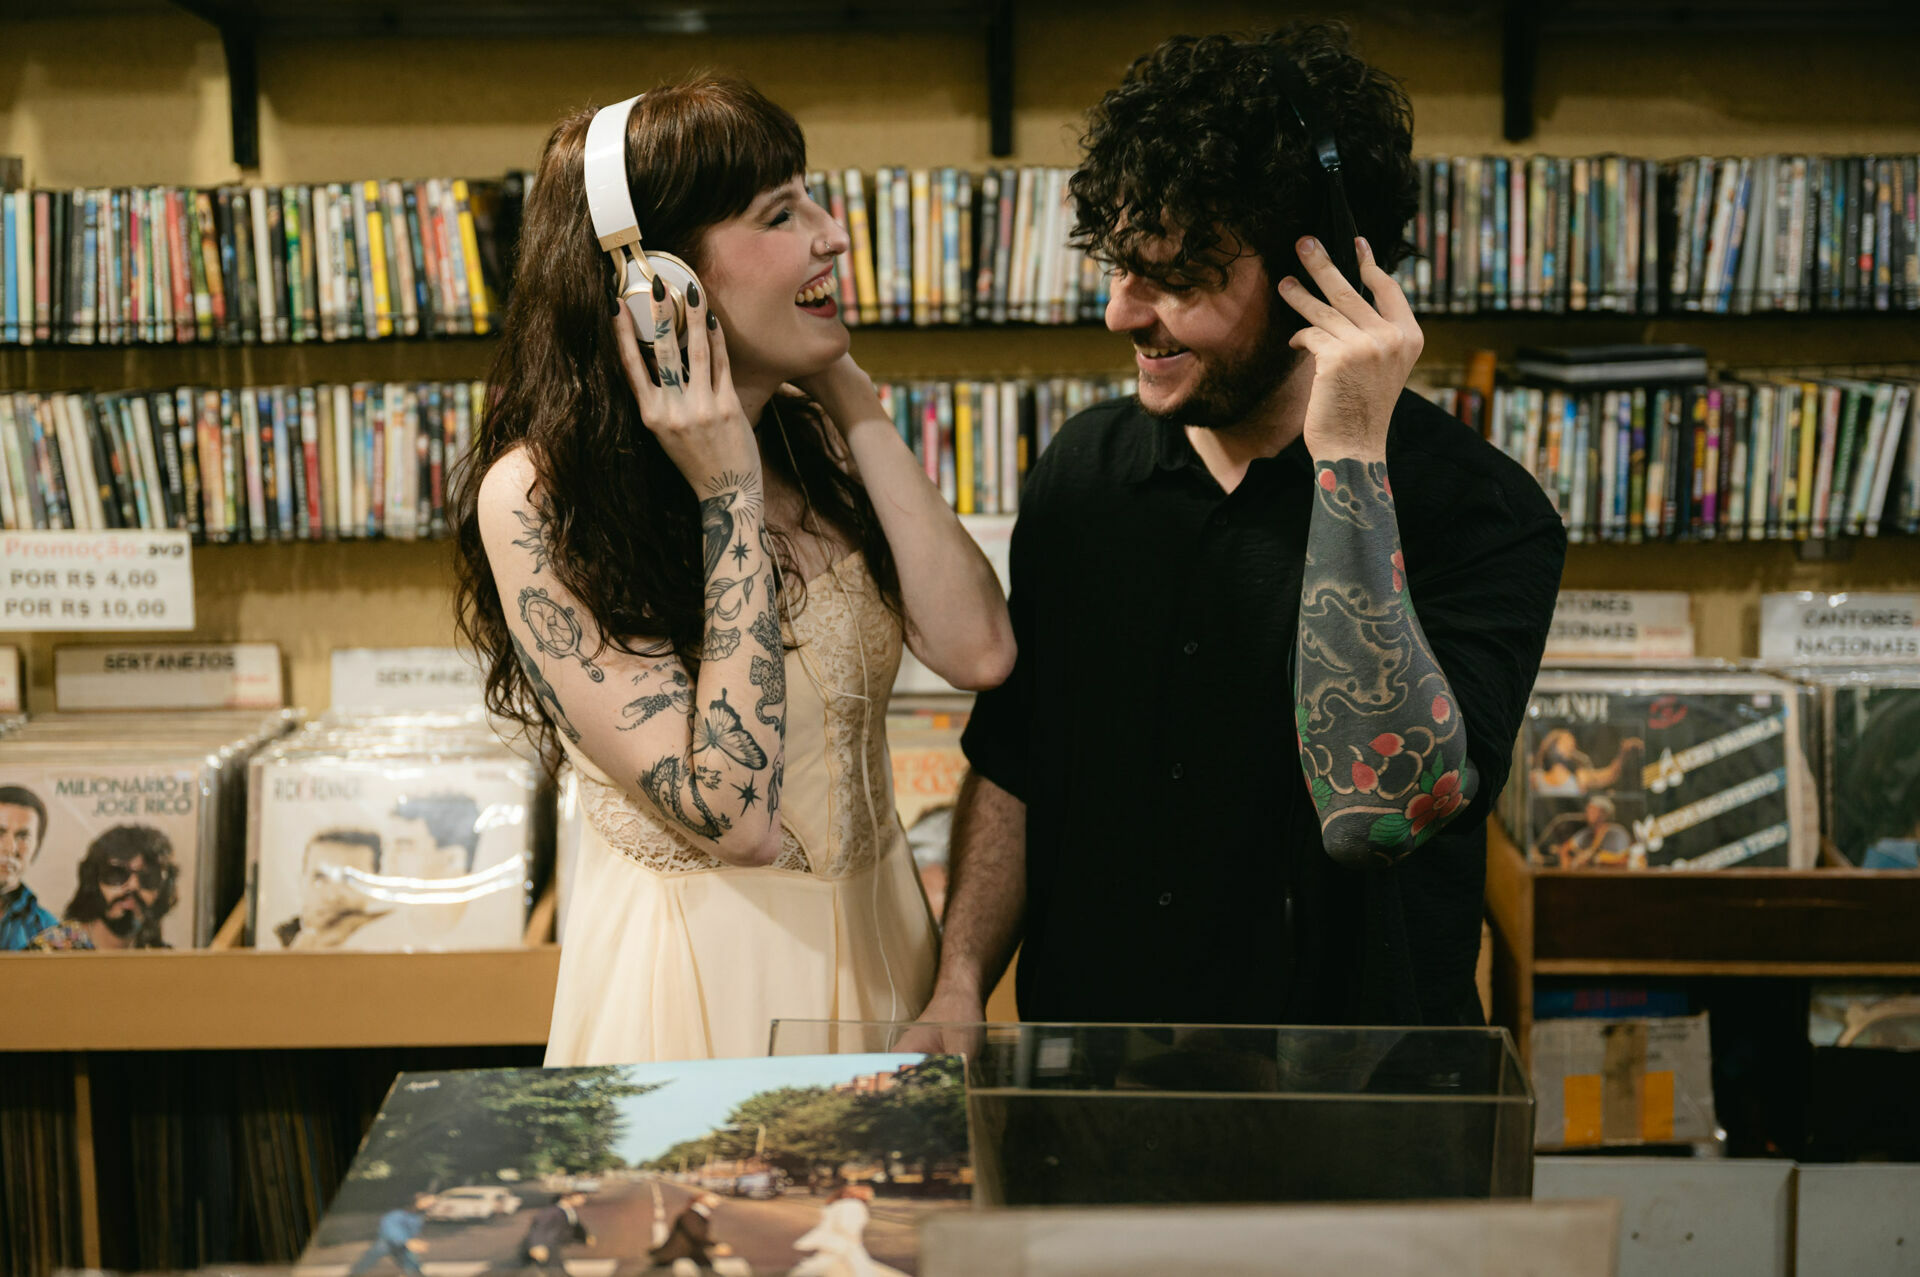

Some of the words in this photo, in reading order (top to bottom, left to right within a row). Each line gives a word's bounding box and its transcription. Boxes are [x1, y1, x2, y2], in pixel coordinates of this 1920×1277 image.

[10, 569, 58, 588] POR
[67, 569, 97, 589] R$
[107, 569, 158, 590] 4,00
[5, 599, 52, 618] POR
[61, 599, 91, 619] R$
[101, 599, 166, 620] 10,00
[1803, 608, 1913, 629] CANTORES
[1795, 635, 1918, 657] NACIONAIS
[104, 651, 235, 672] SERTANEJOS
